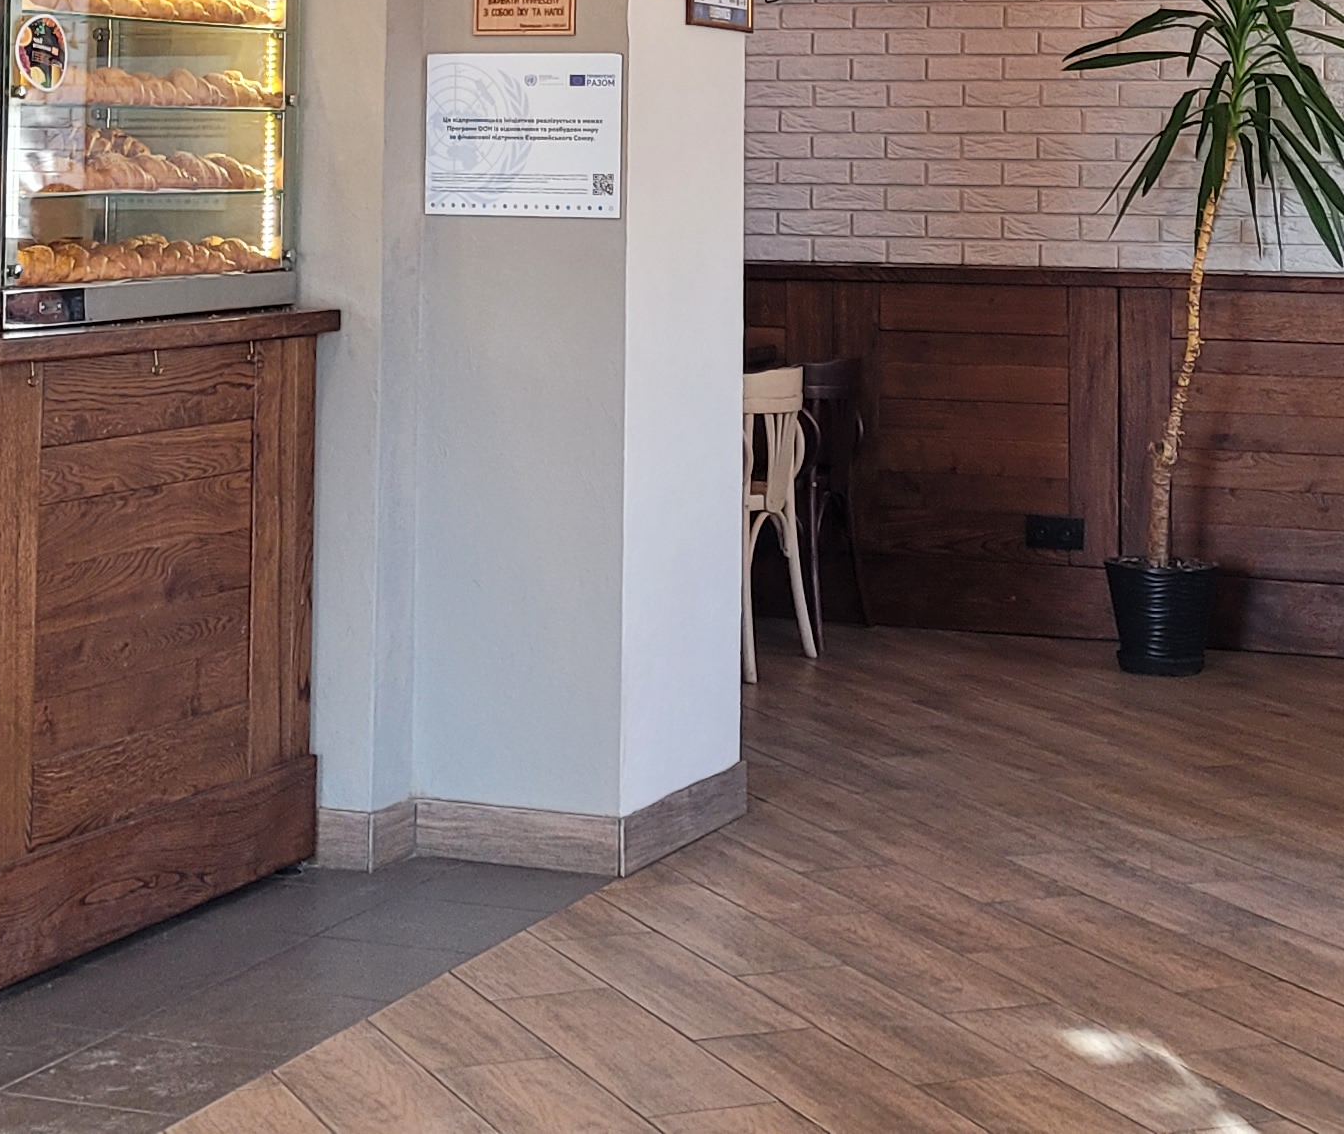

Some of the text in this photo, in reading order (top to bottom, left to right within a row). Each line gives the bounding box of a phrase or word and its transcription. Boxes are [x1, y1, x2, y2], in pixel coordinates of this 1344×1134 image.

[491, 8, 514, 16] СОБОЮ
[532, 8, 541, 16] ТА
[587, 79, 615, 87] РАЗОМ
